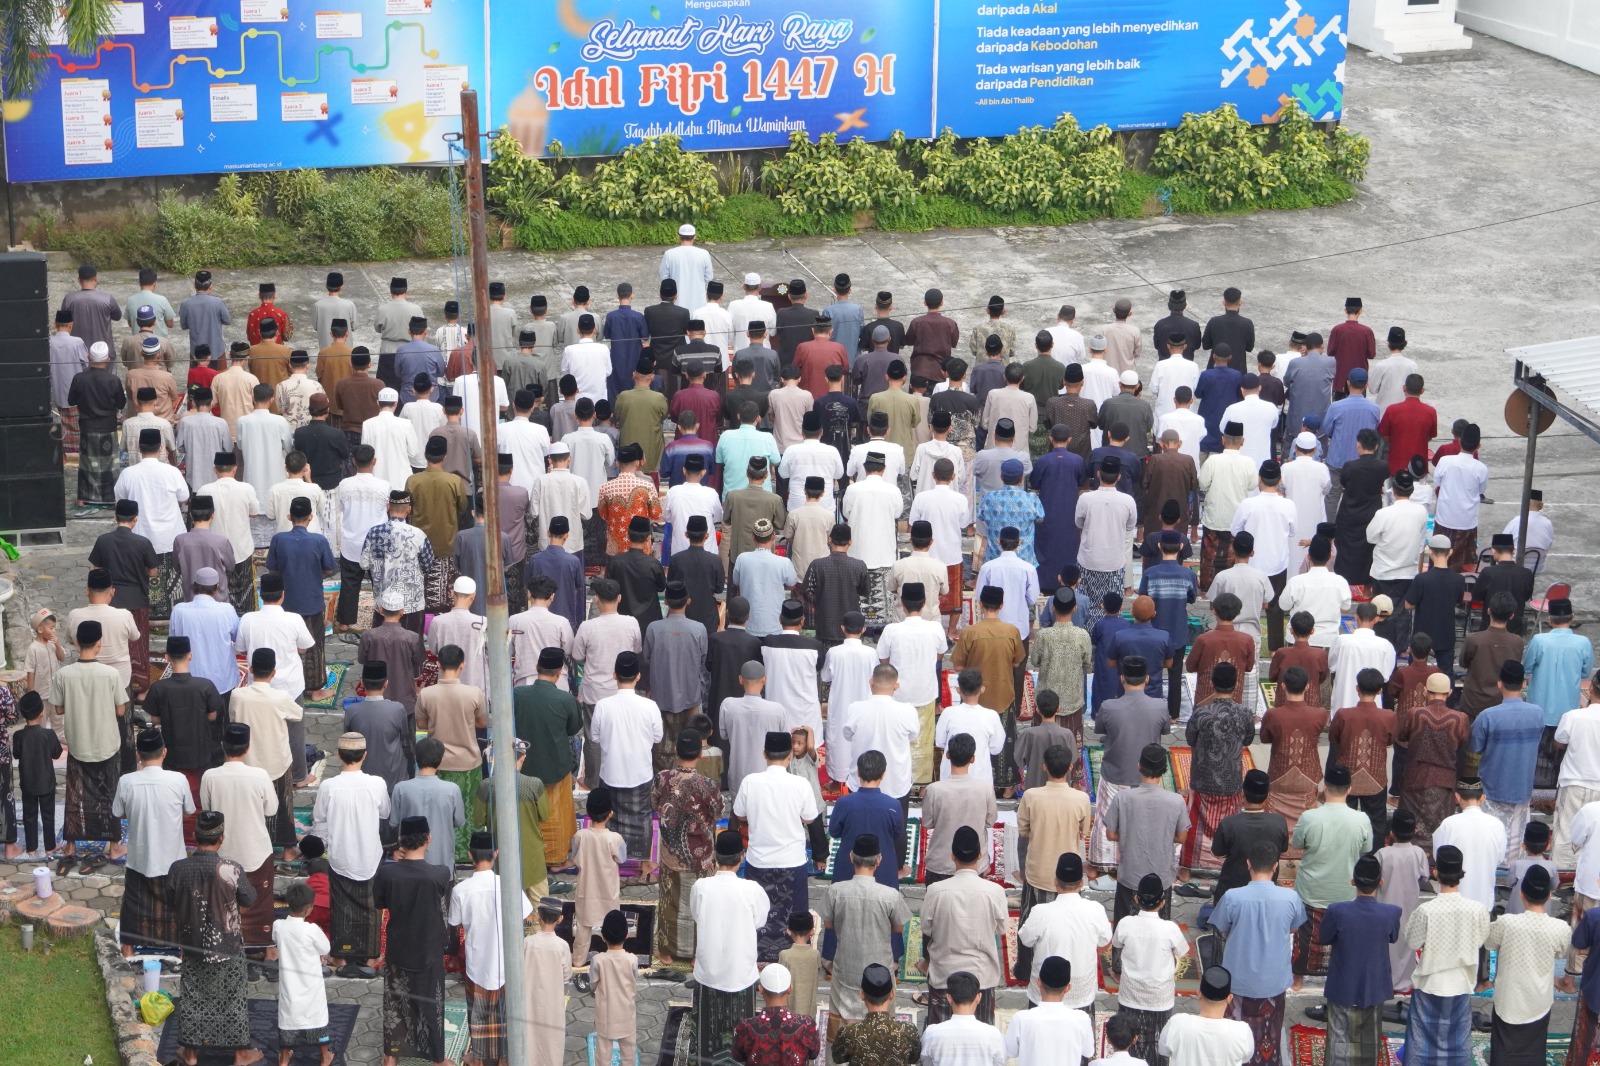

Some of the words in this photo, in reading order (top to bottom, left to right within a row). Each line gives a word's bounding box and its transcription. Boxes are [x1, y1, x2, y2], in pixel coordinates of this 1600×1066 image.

[685, 0, 750, 10] Mengucapkan
[977, 4, 1030, 17] daripada
[1032, 3, 1057, 15] Akal
[581, 15, 702, 62] Selamat
[697, 14, 774, 56] Hari
[780, 11, 853, 53] Raya
[977, 27, 1008, 38] Tiada
[1010, 26, 1060, 37] keadaan
[1061, 25, 1090, 38] yang
[1092, 22, 1120, 34] lebih
[1122, 20, 1198, 35] menyedihkan
[976, 41, 1028, 54] daripada
[1030, 39, 1098, 51] Kebodohan
[976, 64, 1007, 75] Tiada
[1010, 62, 1054, 73] warisan
[1056, 62, 1084, 75] yang
[1086, 59, 1114, 71] lebih
[1116, 58, 1141, 70] baik
[534, 66, 624, 110] Idul
[639, 62, 728, 115] Fitri
[742, 56, 839, 102] 1447
[854, 53, 897, 97] H
[975, 78, 1027, 91] daripada
[1029, 76, 1094, 88] Pendidikan
[988, 98, 1000, 106] bin
[1001, 97, 1013, 105] Abi
[1014, 96, 1035, 104] Thalib
